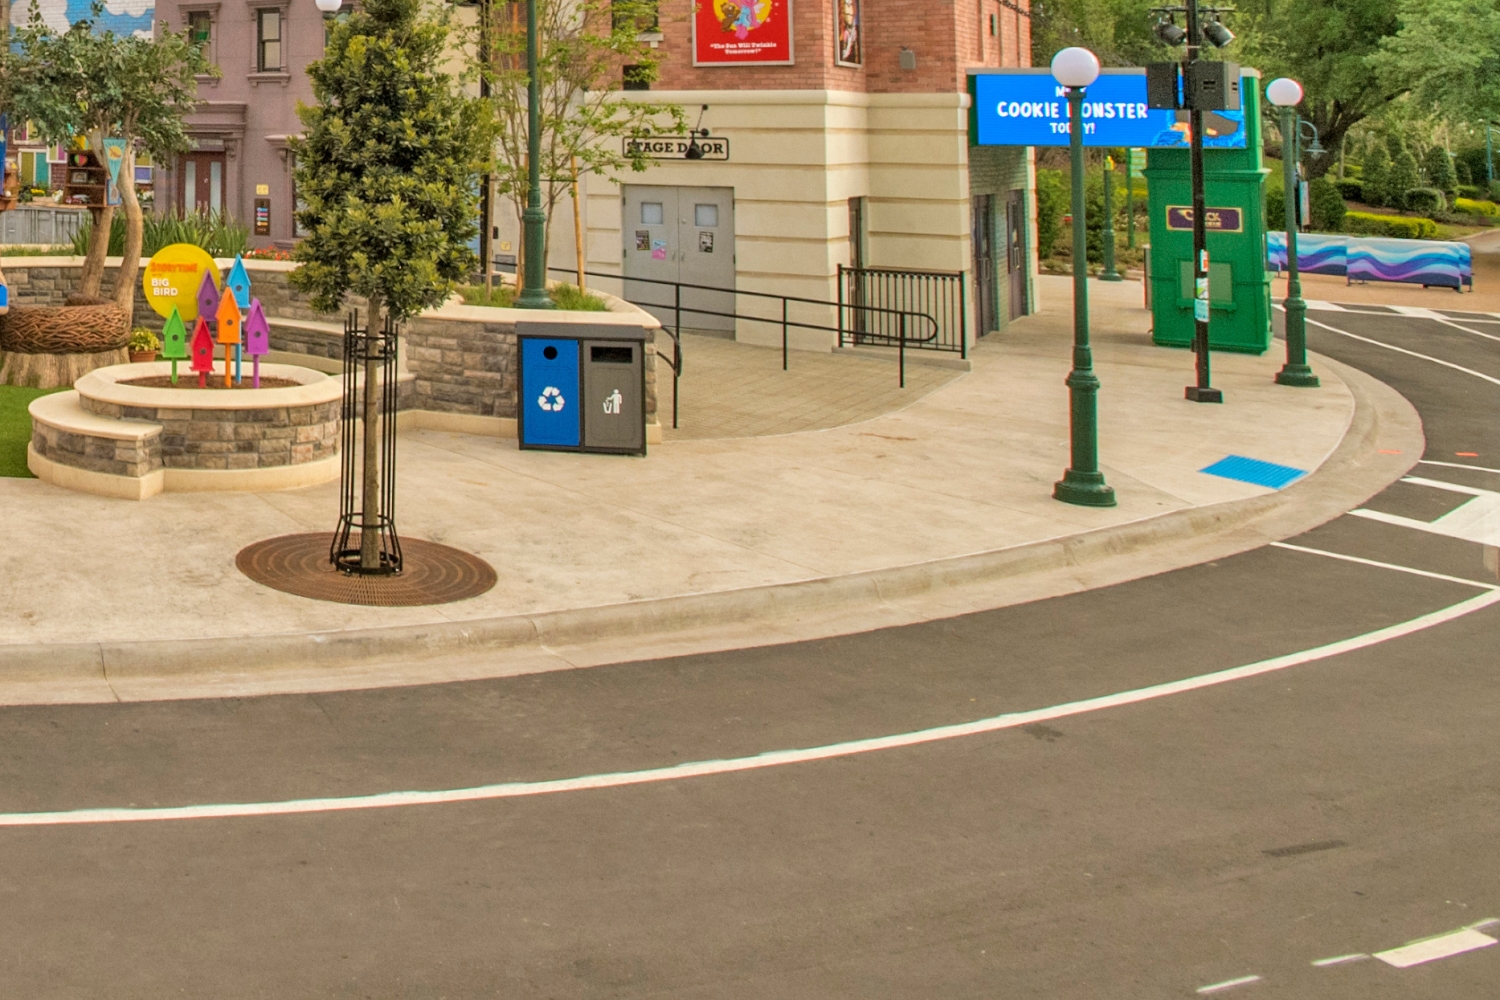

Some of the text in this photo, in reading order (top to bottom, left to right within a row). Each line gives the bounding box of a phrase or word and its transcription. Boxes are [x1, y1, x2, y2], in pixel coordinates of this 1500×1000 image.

[997, 102, 1059, 117] COOKIE
[627, 142, 724, 153] STAGE DOR
[151, 262, 197, 272] STORYTIME
[151, 278, 170, 286] BIG
[153, 287, 179, 296] BIRD
